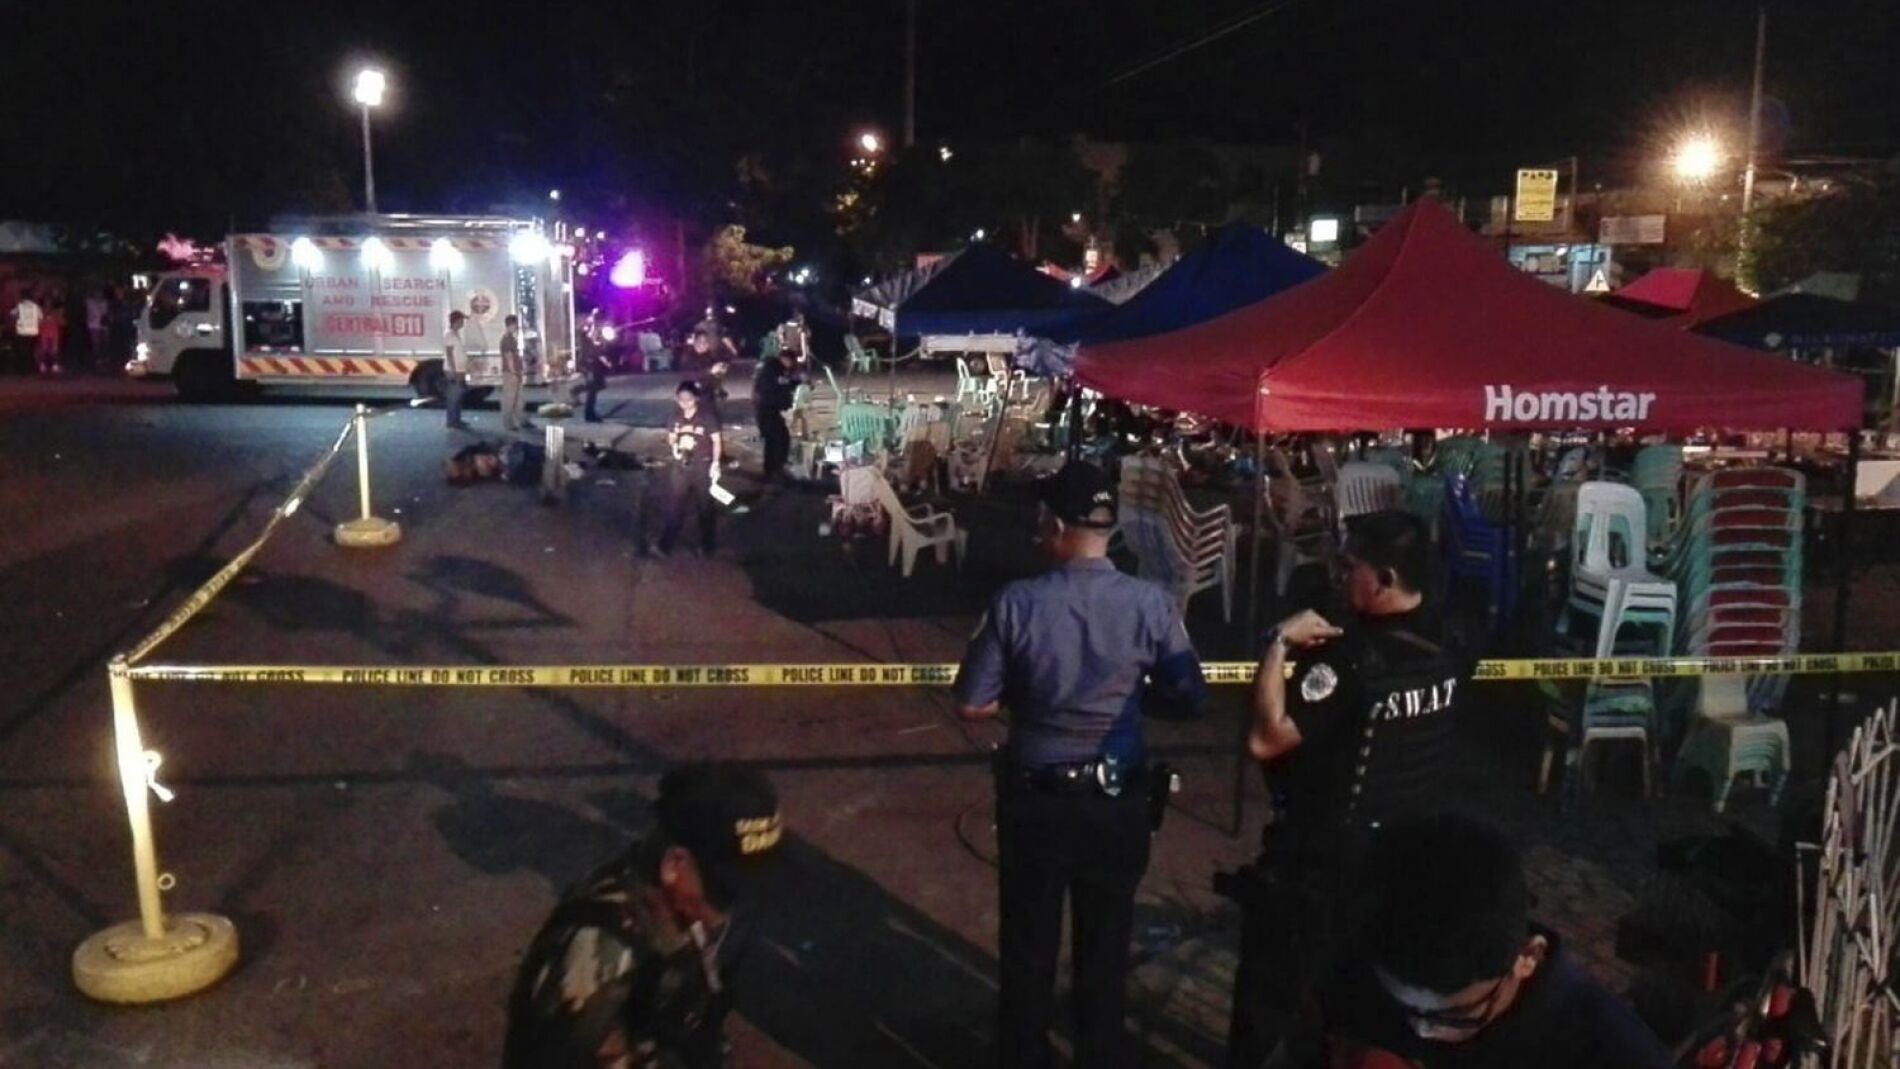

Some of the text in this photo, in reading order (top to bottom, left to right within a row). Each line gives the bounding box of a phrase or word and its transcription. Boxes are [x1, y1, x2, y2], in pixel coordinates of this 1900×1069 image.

[305, 276, 445, 290] URBAN SEARCH
[323, 295, 433, 307] AND RESCUE
[395, 315, 422, 334] 911
[1484, 384, 1656, 421] Homstar
[256, 669, 304, 682] CROSS
[342, 669, 535, 683] POLICE LINE DO NOT CROSS
[570, 668, 749, 683] POLICE LINE DO NOT CROSS
[782, 667, 952, 682] POLICE LINE DO NOT CROSS
[1534, 662, 1569, 676] POLICE
[1573, 662, 1594, 675] LINE
